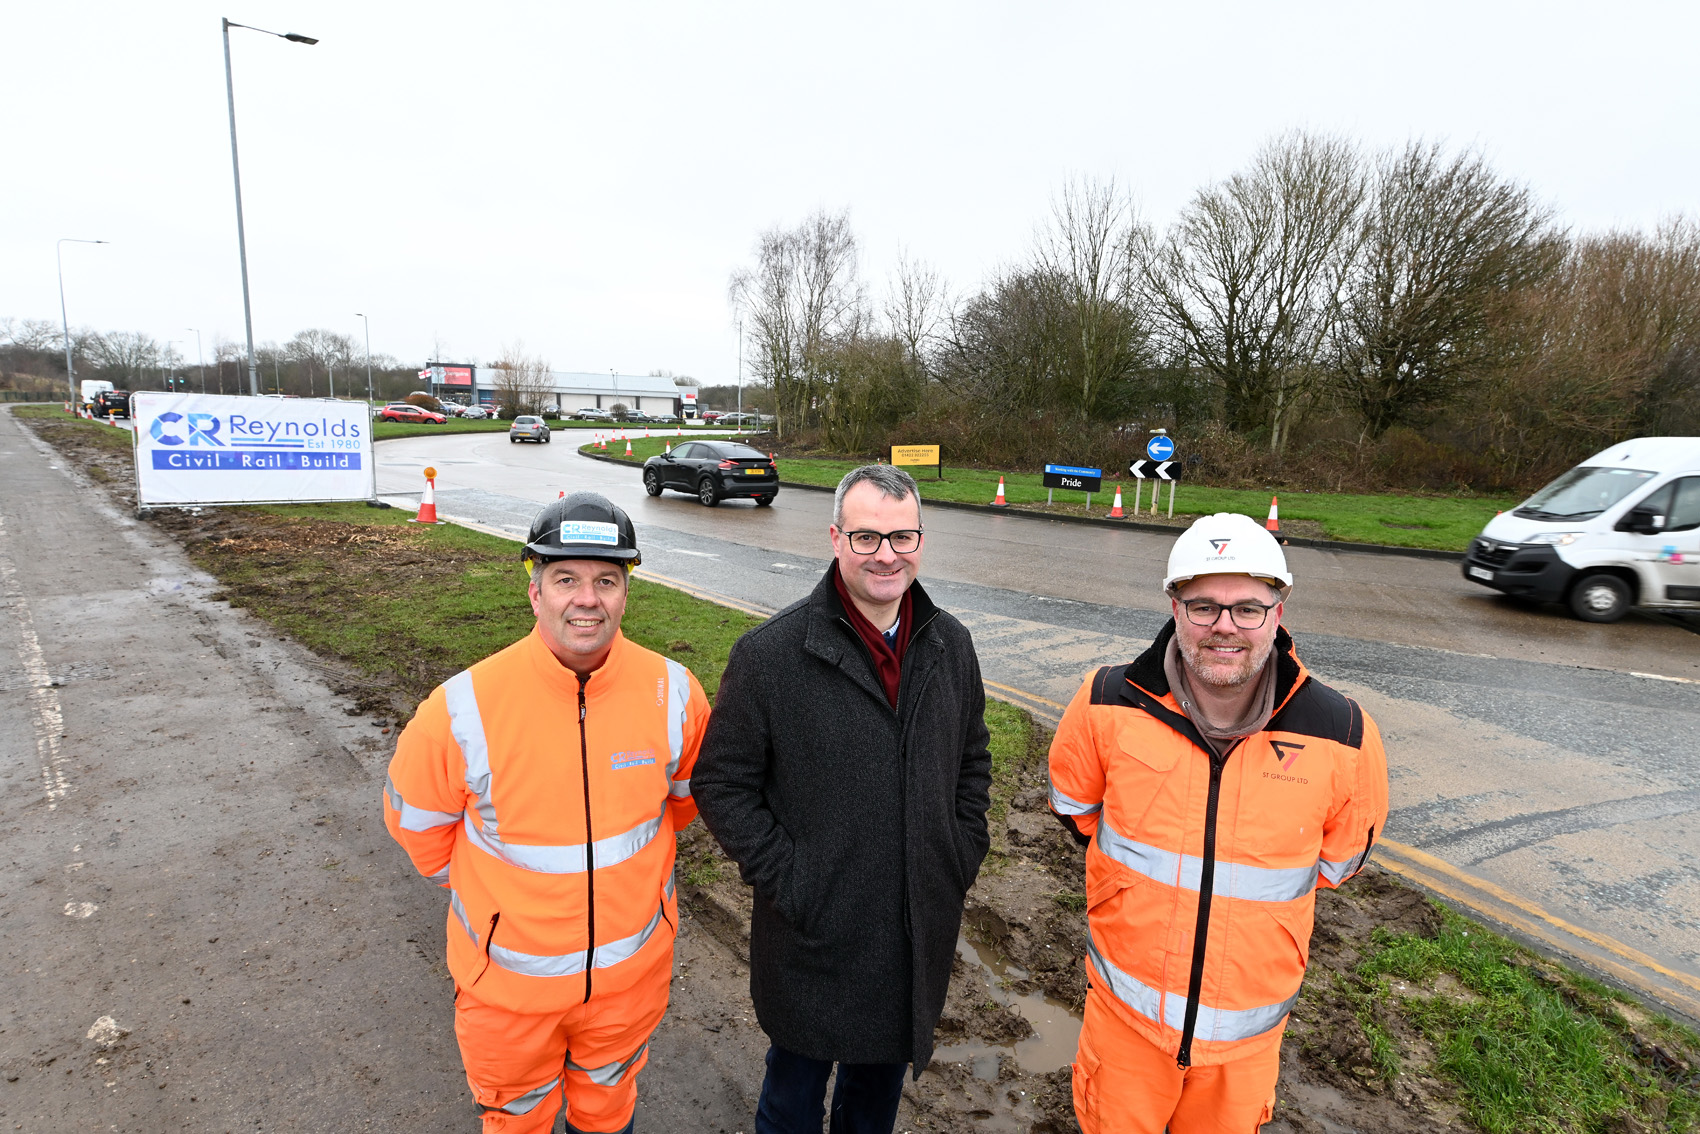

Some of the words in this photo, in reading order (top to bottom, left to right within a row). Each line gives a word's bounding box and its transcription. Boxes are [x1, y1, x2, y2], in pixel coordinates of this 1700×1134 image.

[150, 411, 226, 447] CR
[230, 415, 361, 442] Reynolds
[307, 439, 325, 449] Est
[330, 439, 361, 450] 1980
[168, 453, 220, 467] Civil
[242, 453, 281, 468] Rail
[301, 454, 349, 468] Build
[1061, 477, 1082, 487] Pride
[563, 524, 581, 533] CR
[582, 524, 616, 533] Reynolds
[611, 752, 626, 763] CR
[1270, 773, 1295, 782] GROUP
[1297, 777, 1309, 785] LTD
